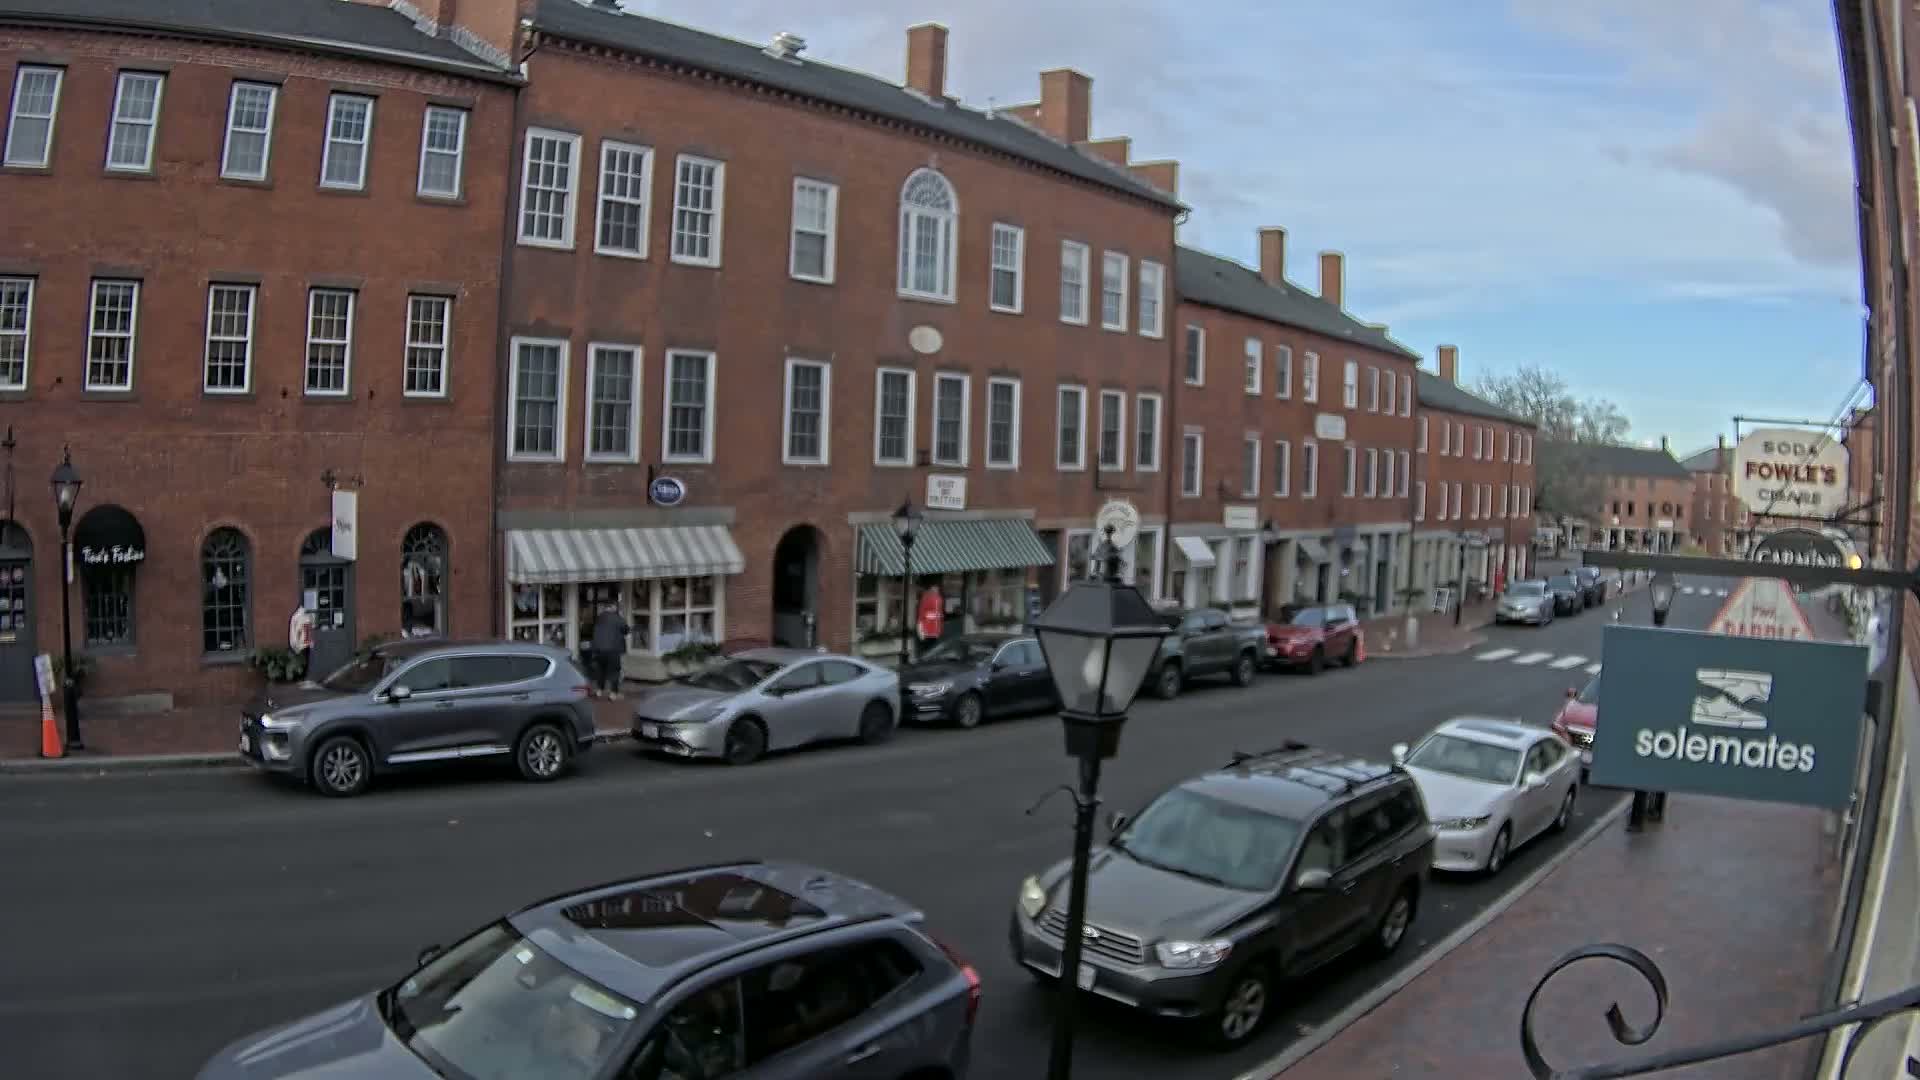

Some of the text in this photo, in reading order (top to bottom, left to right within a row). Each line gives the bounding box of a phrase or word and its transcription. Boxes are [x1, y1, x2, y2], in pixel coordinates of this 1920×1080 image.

[1763, 440, 1821, 458] SODA
[1745, 461, 1838, 485] FOWLE'S
[1635, 726, 1816, 773] solemates
